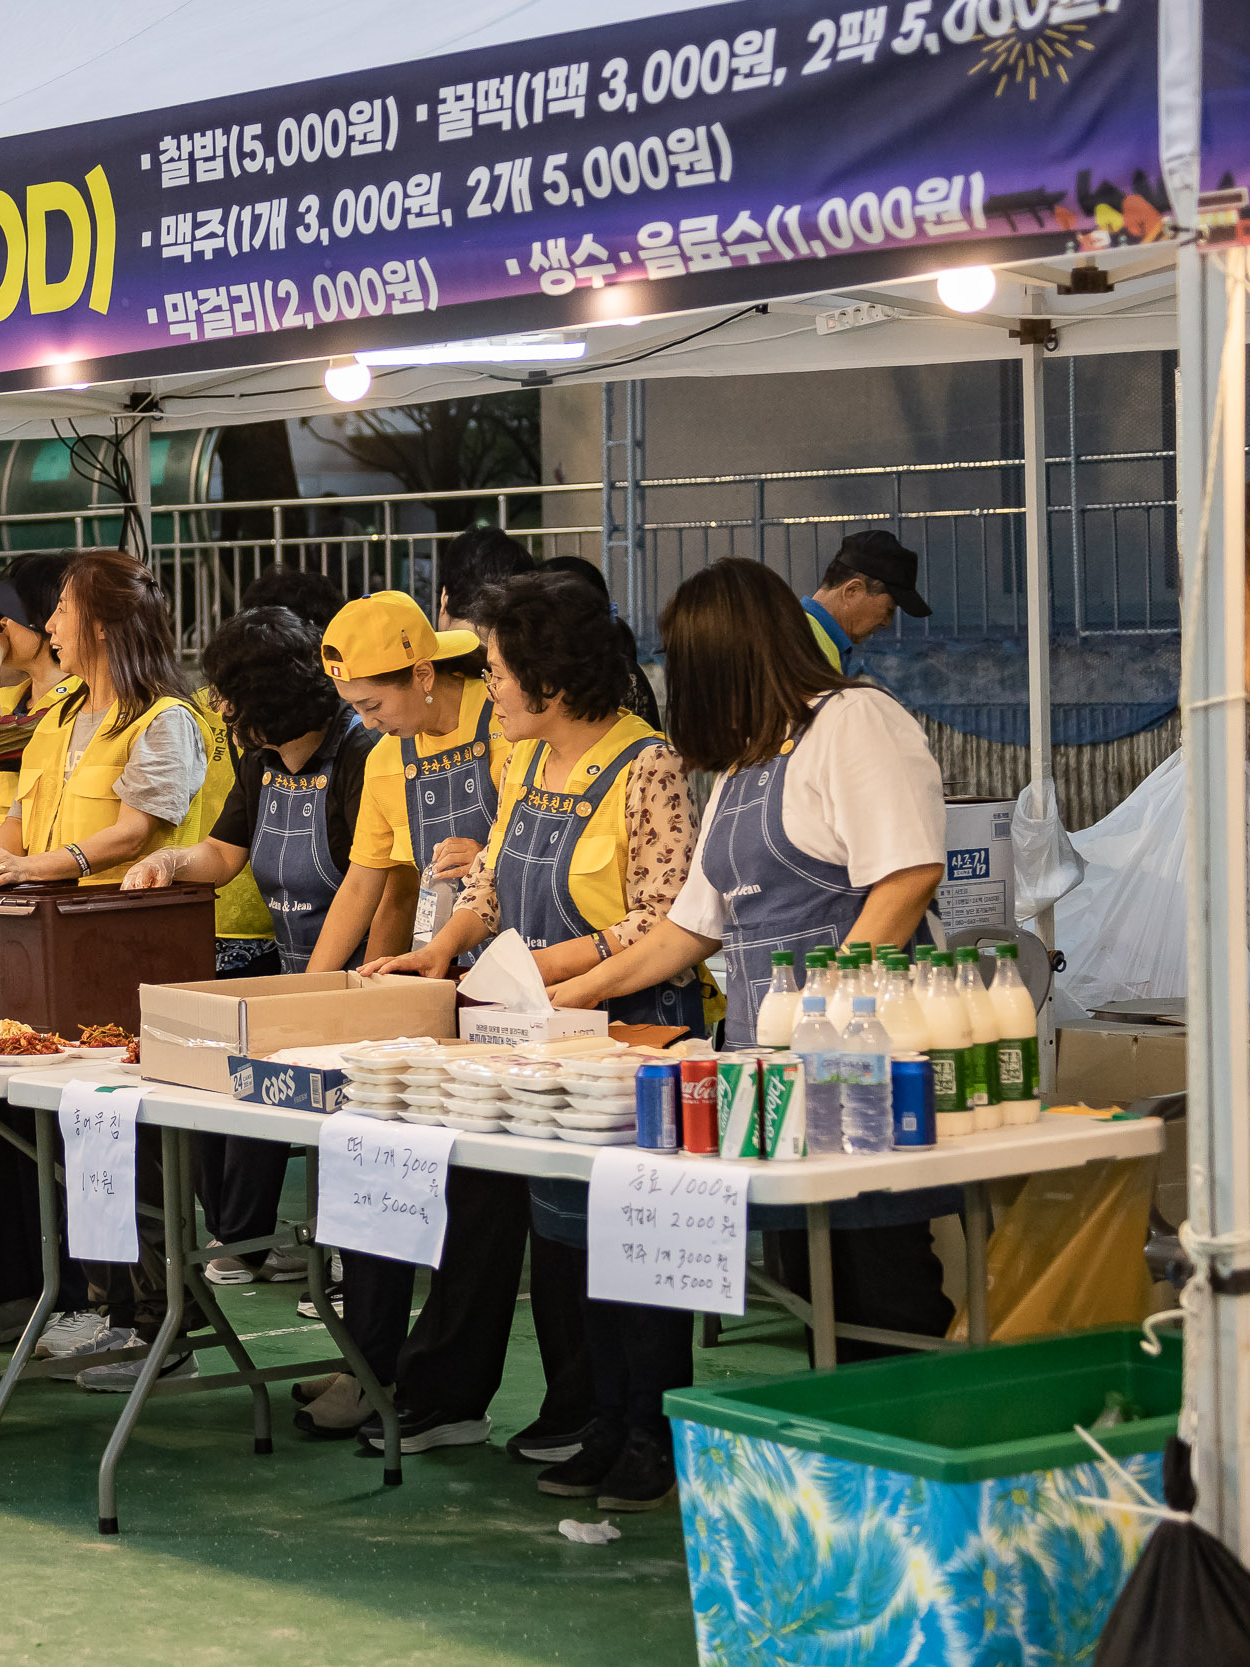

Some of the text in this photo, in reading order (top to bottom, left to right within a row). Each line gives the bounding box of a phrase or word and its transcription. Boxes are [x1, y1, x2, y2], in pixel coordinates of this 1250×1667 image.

[801, 6, 888, 76] 2팩
[466, 156, 534, 219] 2개
[542, 122, 734, 208] 5,000원)
[164, 256, 438, 341] 막걸리(2,000원)
[951, 850, 986, 875] 사조김
[281, 900, 290, 912] &
[291, 900, 312, 911] Jean
[526, 936, 547, 948] Jean
[234, 1073, 243, 1092] 24
[74, 1108, 121, 1140] 홍어무침
